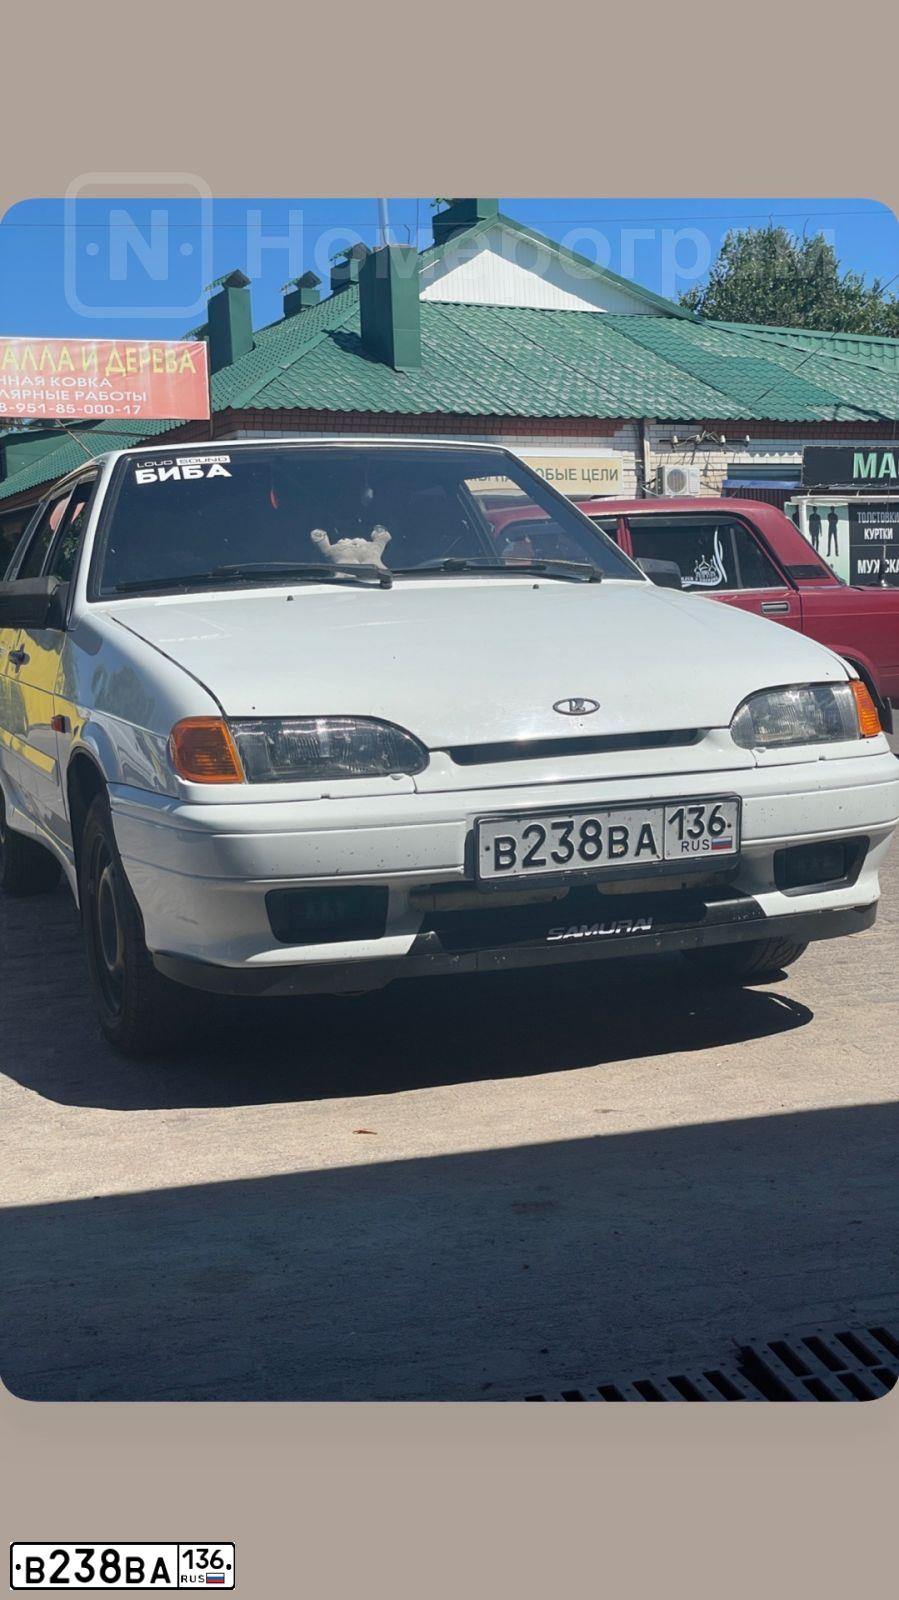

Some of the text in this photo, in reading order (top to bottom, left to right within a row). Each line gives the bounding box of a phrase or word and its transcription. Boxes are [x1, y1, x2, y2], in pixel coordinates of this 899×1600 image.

[81, 345, 99, 372] И
[104, 346, 197, 377] ДЕРЕВА
[50, 376, 113, 388] КОВКА
[74, 390, 147, 402] РАБОТЫ
[136, 456, 229, 468] LOUD SOUND
[853, 452, 899, 478] МА
[135, 463, 233, 485] БИБА
[581, 468, 619, 483] ЦЕЛИ
[864, 527, 894, 540] КУРТКИ
[493, 804, 727, 871] В238ВА 136
[681, 838, 711, 853] RUS
[546, 917, 654, 941] SAMURAI
